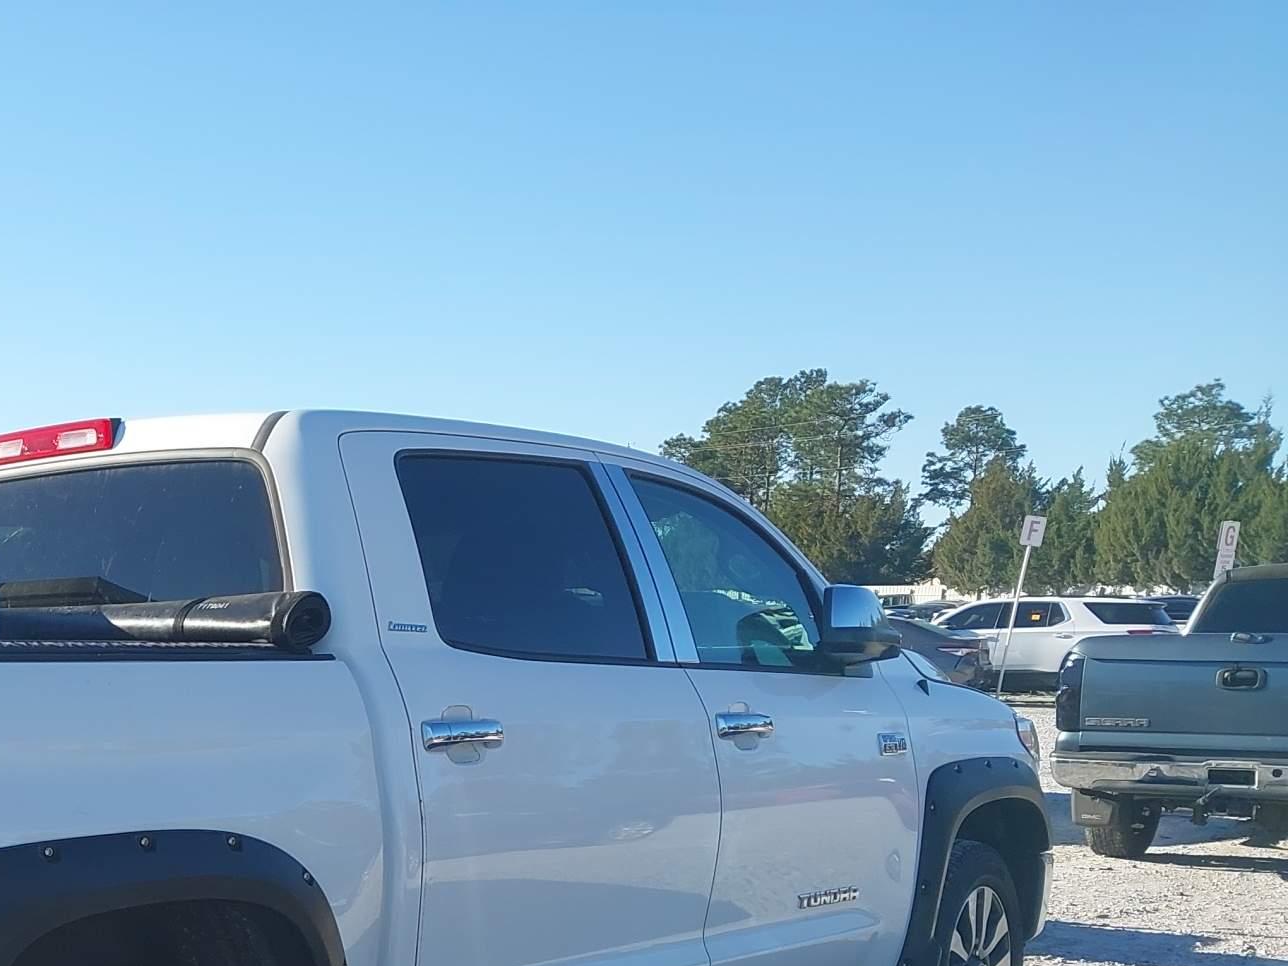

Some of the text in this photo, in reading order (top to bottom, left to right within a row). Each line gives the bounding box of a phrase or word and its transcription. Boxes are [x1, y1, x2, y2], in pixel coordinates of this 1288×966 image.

[1027, 520, 1041, 541] F
[1225, 525, 1236, 546] G
[797, 886, 860, 909] TUNDRA
